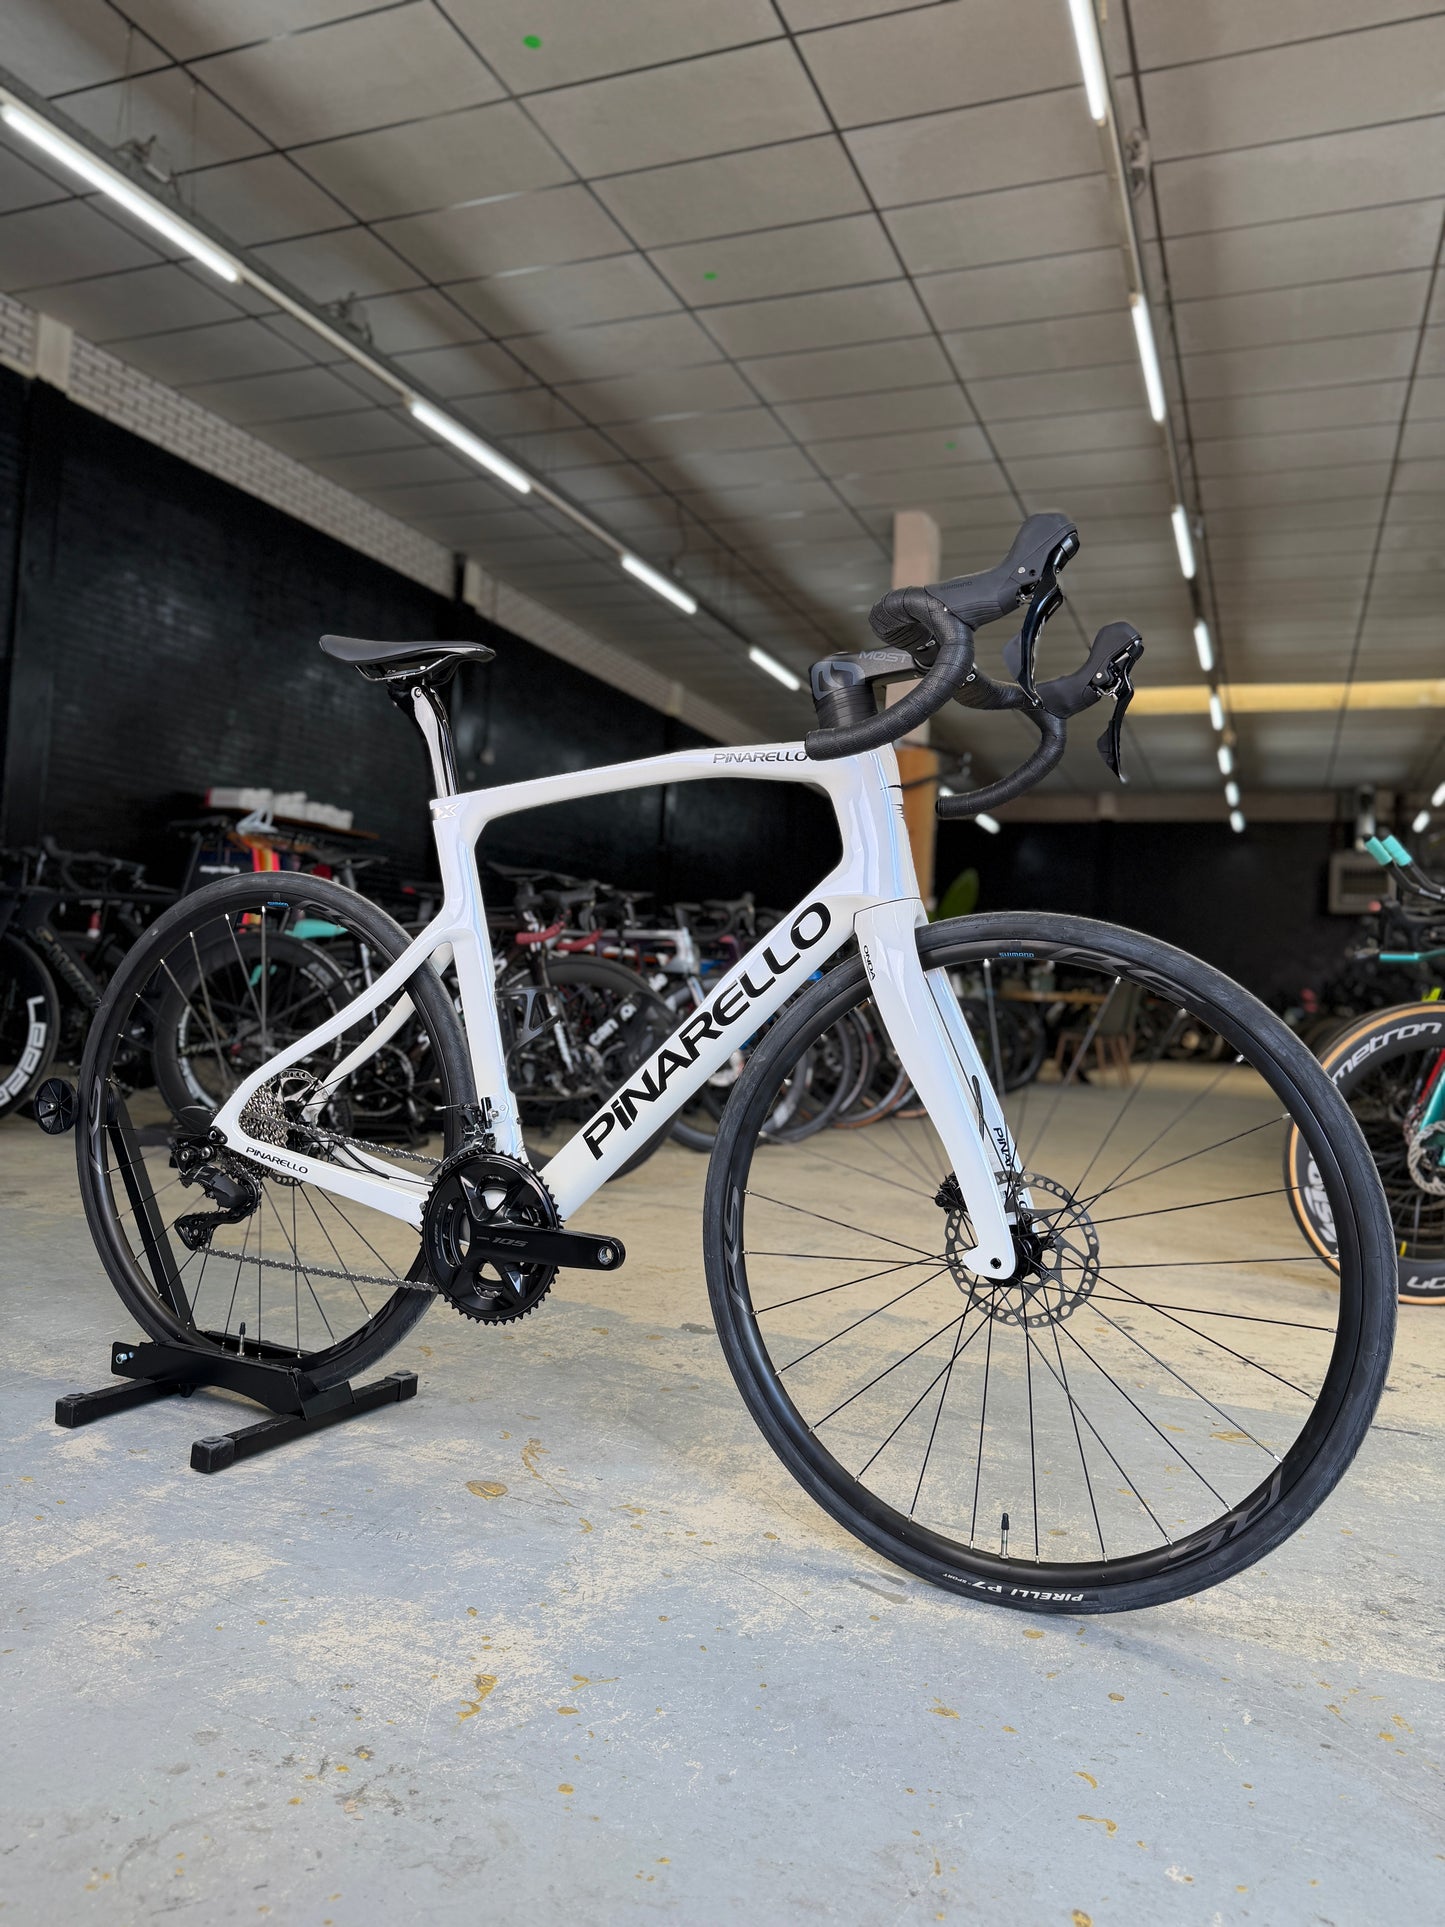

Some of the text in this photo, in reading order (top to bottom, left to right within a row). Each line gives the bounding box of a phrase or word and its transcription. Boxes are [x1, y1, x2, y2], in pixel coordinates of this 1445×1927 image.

[863, 945, 876, 981] ONDA
[583, 902, 831, 1160] PINARELLO
[1331, 1021, 1443, 1086] metron
[246, 1146, 308, 1174] PINARELLO
[492, 1237, 529, 1247] 105
[972, 1580, 1003, 1593] P7
[1010, 1588, 1084, 1602] PIRELLI
